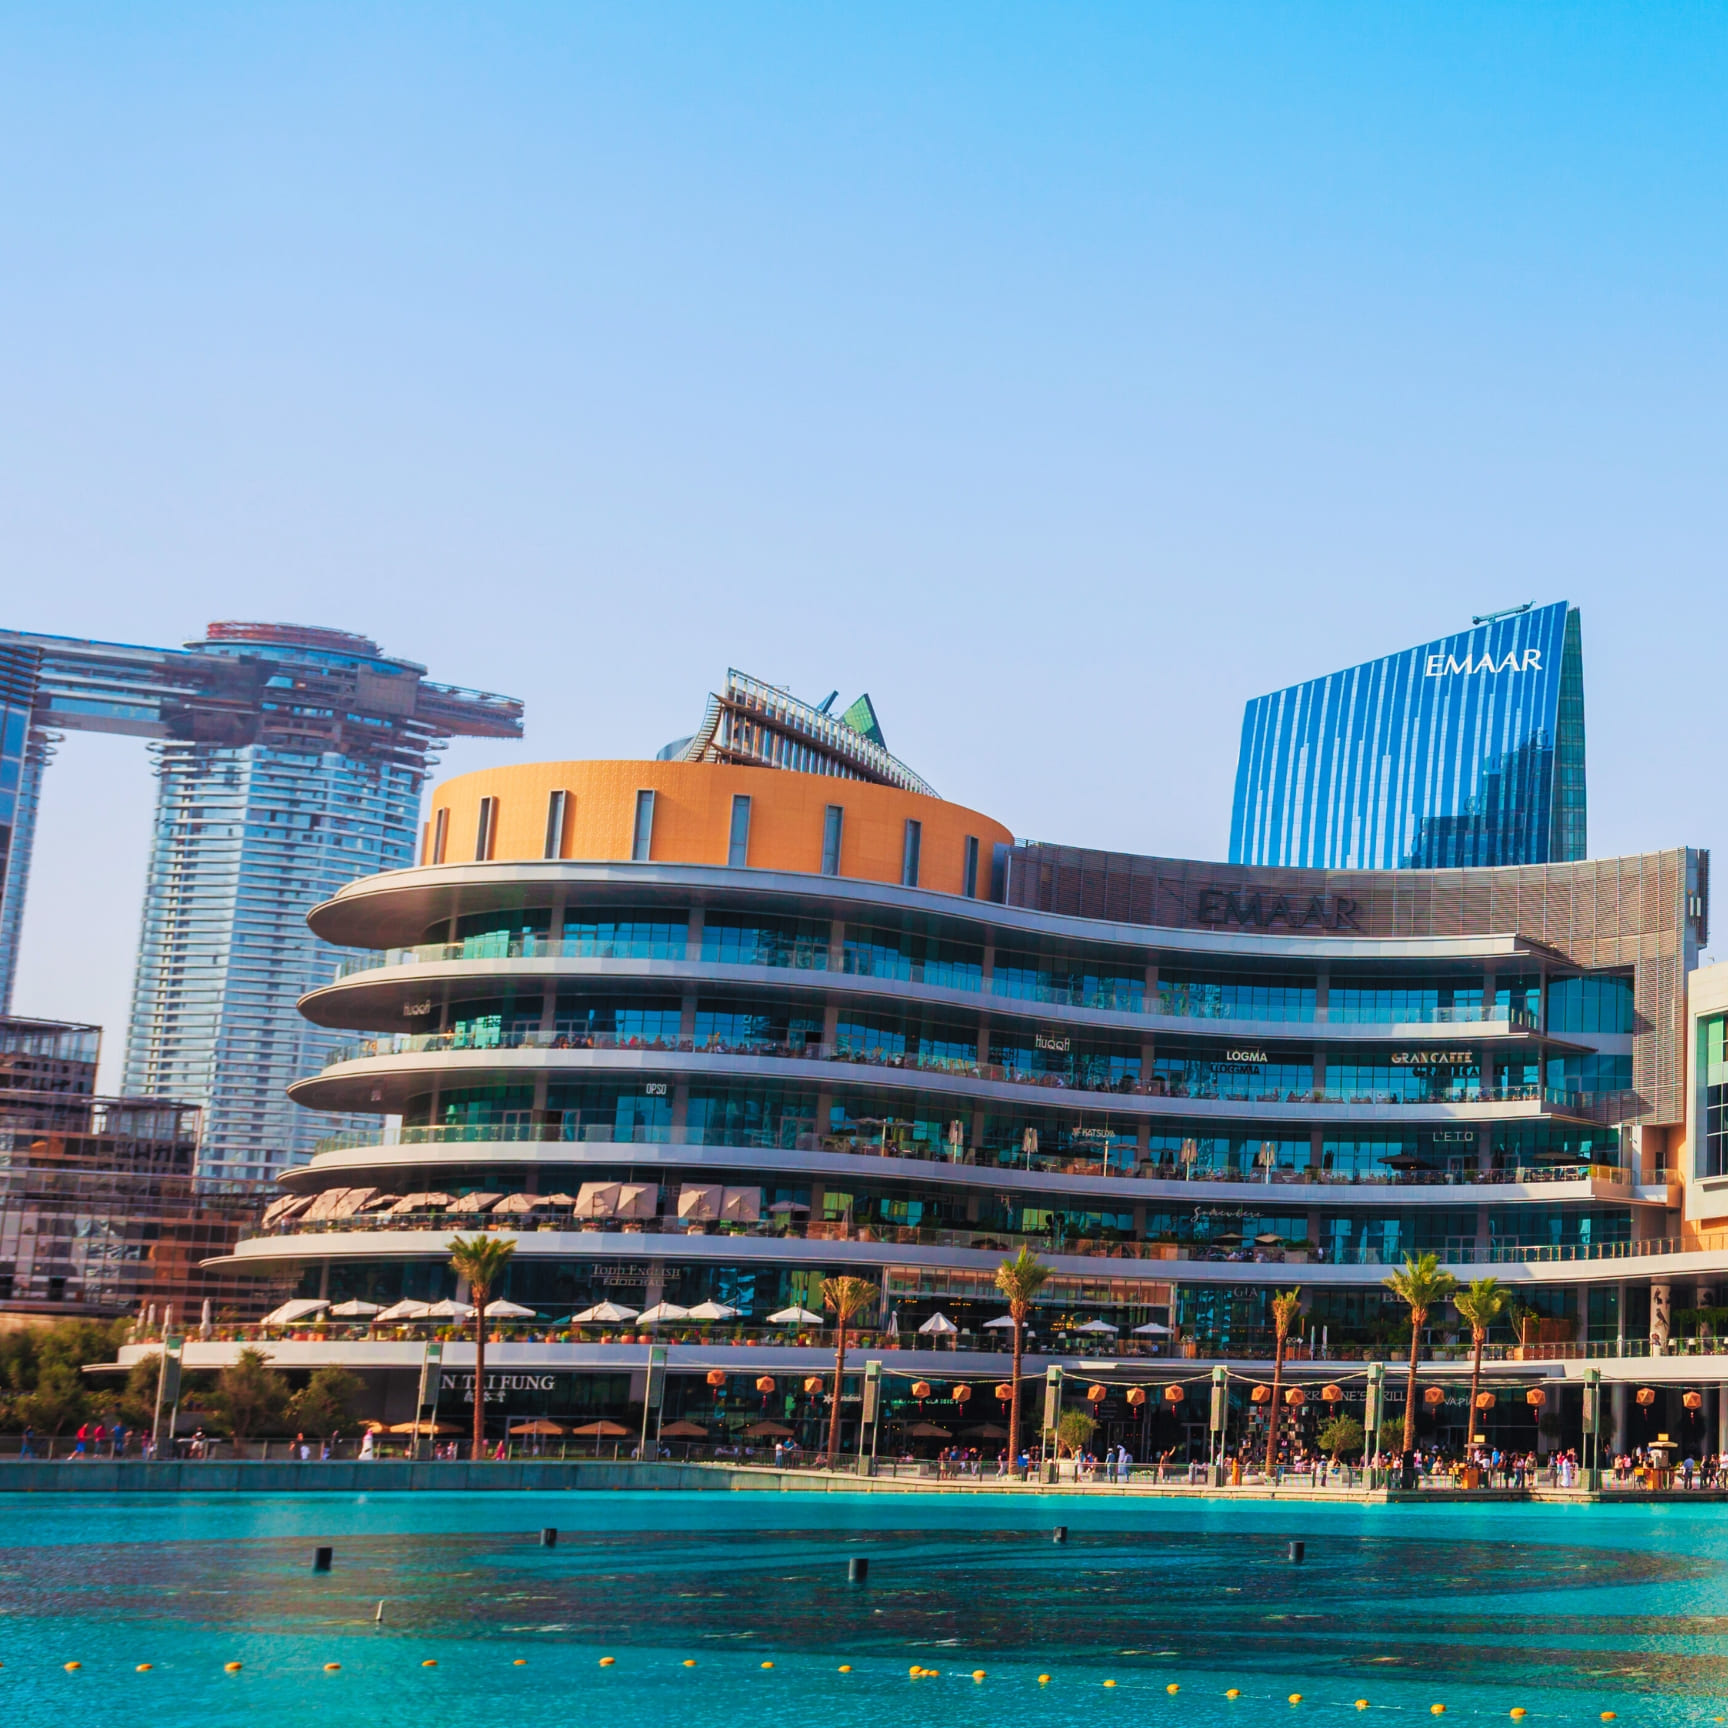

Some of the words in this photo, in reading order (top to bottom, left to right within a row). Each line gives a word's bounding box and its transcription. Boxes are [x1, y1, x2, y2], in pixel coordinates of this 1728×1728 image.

[1425, 648, 1543, 677] EMAAR
[1199, 889, 1362, 930] EMAAR
[1226, 1050, 1268, 1062] LOGMA
[646, 1083, 667, 1095] OPSO
[1432, 1131, 1473, 1141] L'ETO
[462, 1375, 496, 1389] TI
[501, 1375, 555, 1390] FUNG
